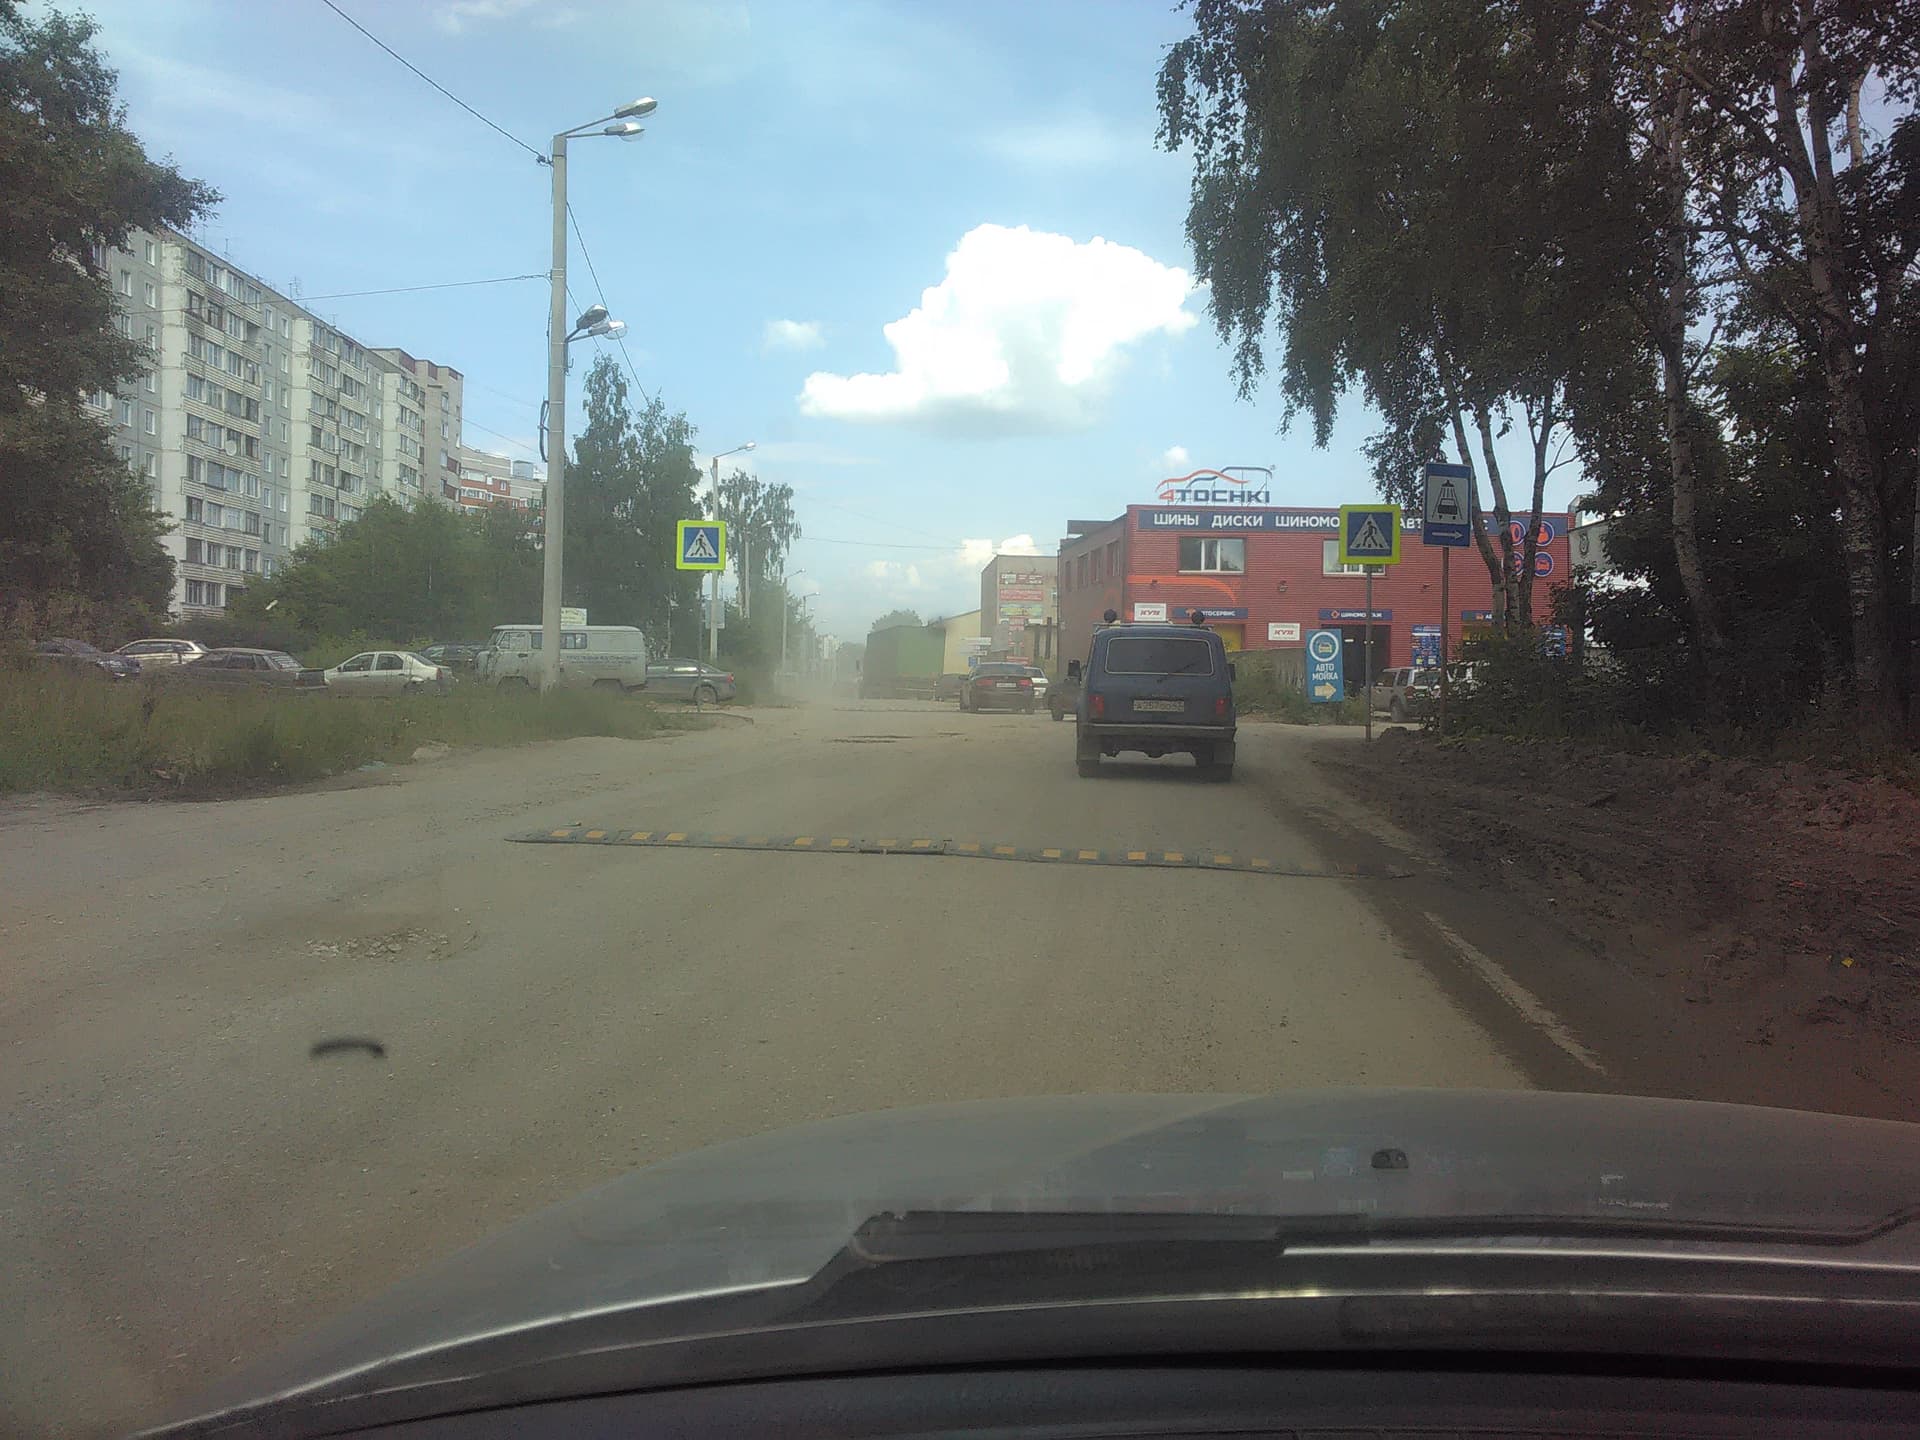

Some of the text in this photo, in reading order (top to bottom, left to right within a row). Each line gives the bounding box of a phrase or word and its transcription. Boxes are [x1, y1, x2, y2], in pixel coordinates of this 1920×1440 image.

[1158, 489, 1270, 503] 4TOCHKI
[1153, 513, 1340, 529] ШИНЫ ДИСКИ ШИНОМО
[1315, 663, 1335, 672] АВТО
[1312, 671, 1339, 681] МОЙКА
